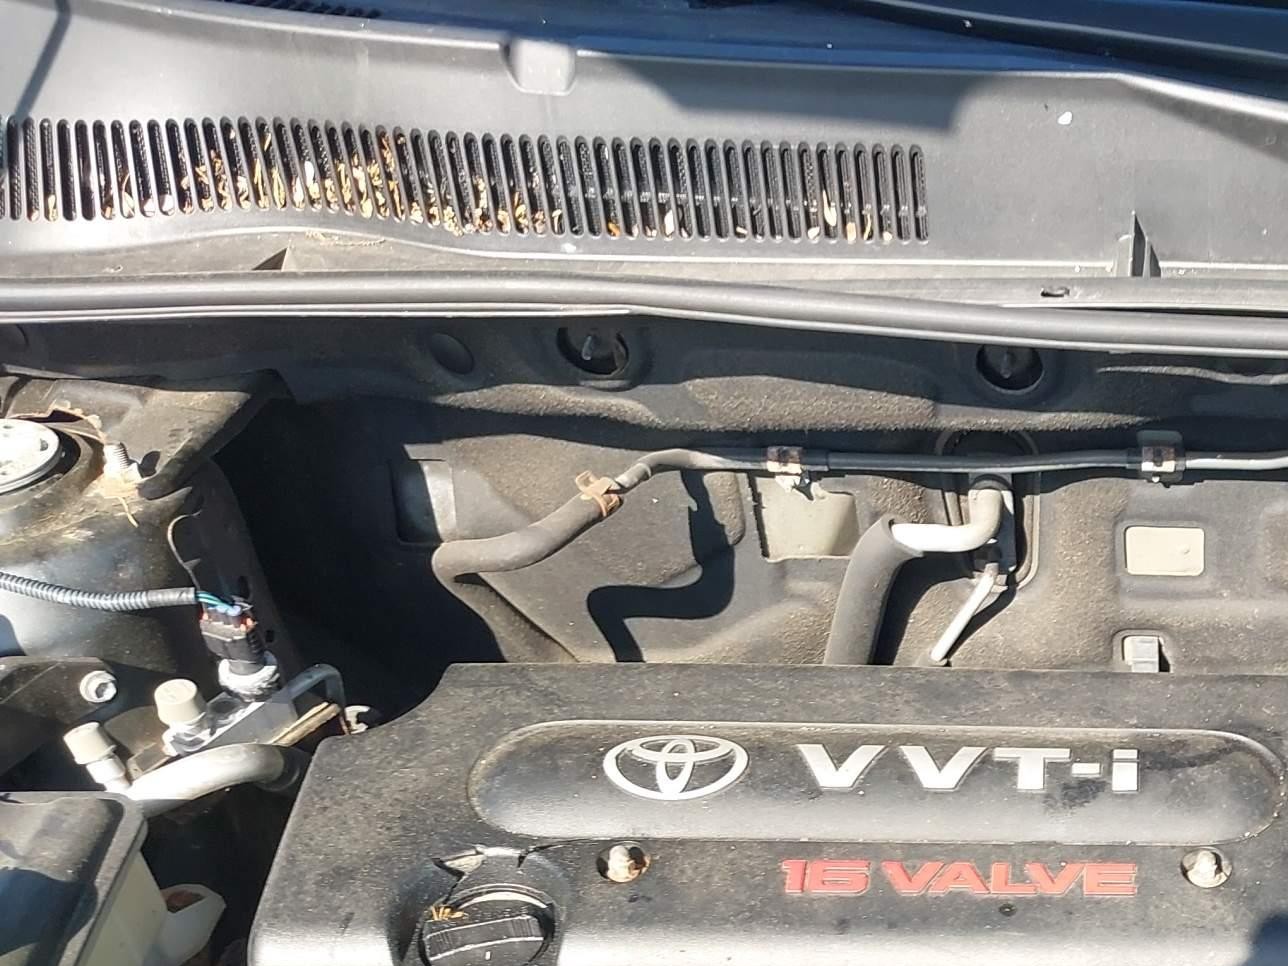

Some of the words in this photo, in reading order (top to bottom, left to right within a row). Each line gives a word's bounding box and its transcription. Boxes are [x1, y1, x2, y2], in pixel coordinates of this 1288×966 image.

[797, 743, 1139, 791] VVT-i
[781, 858, 871, 894] 16
[881, 859, 1138, 896] VALVE
